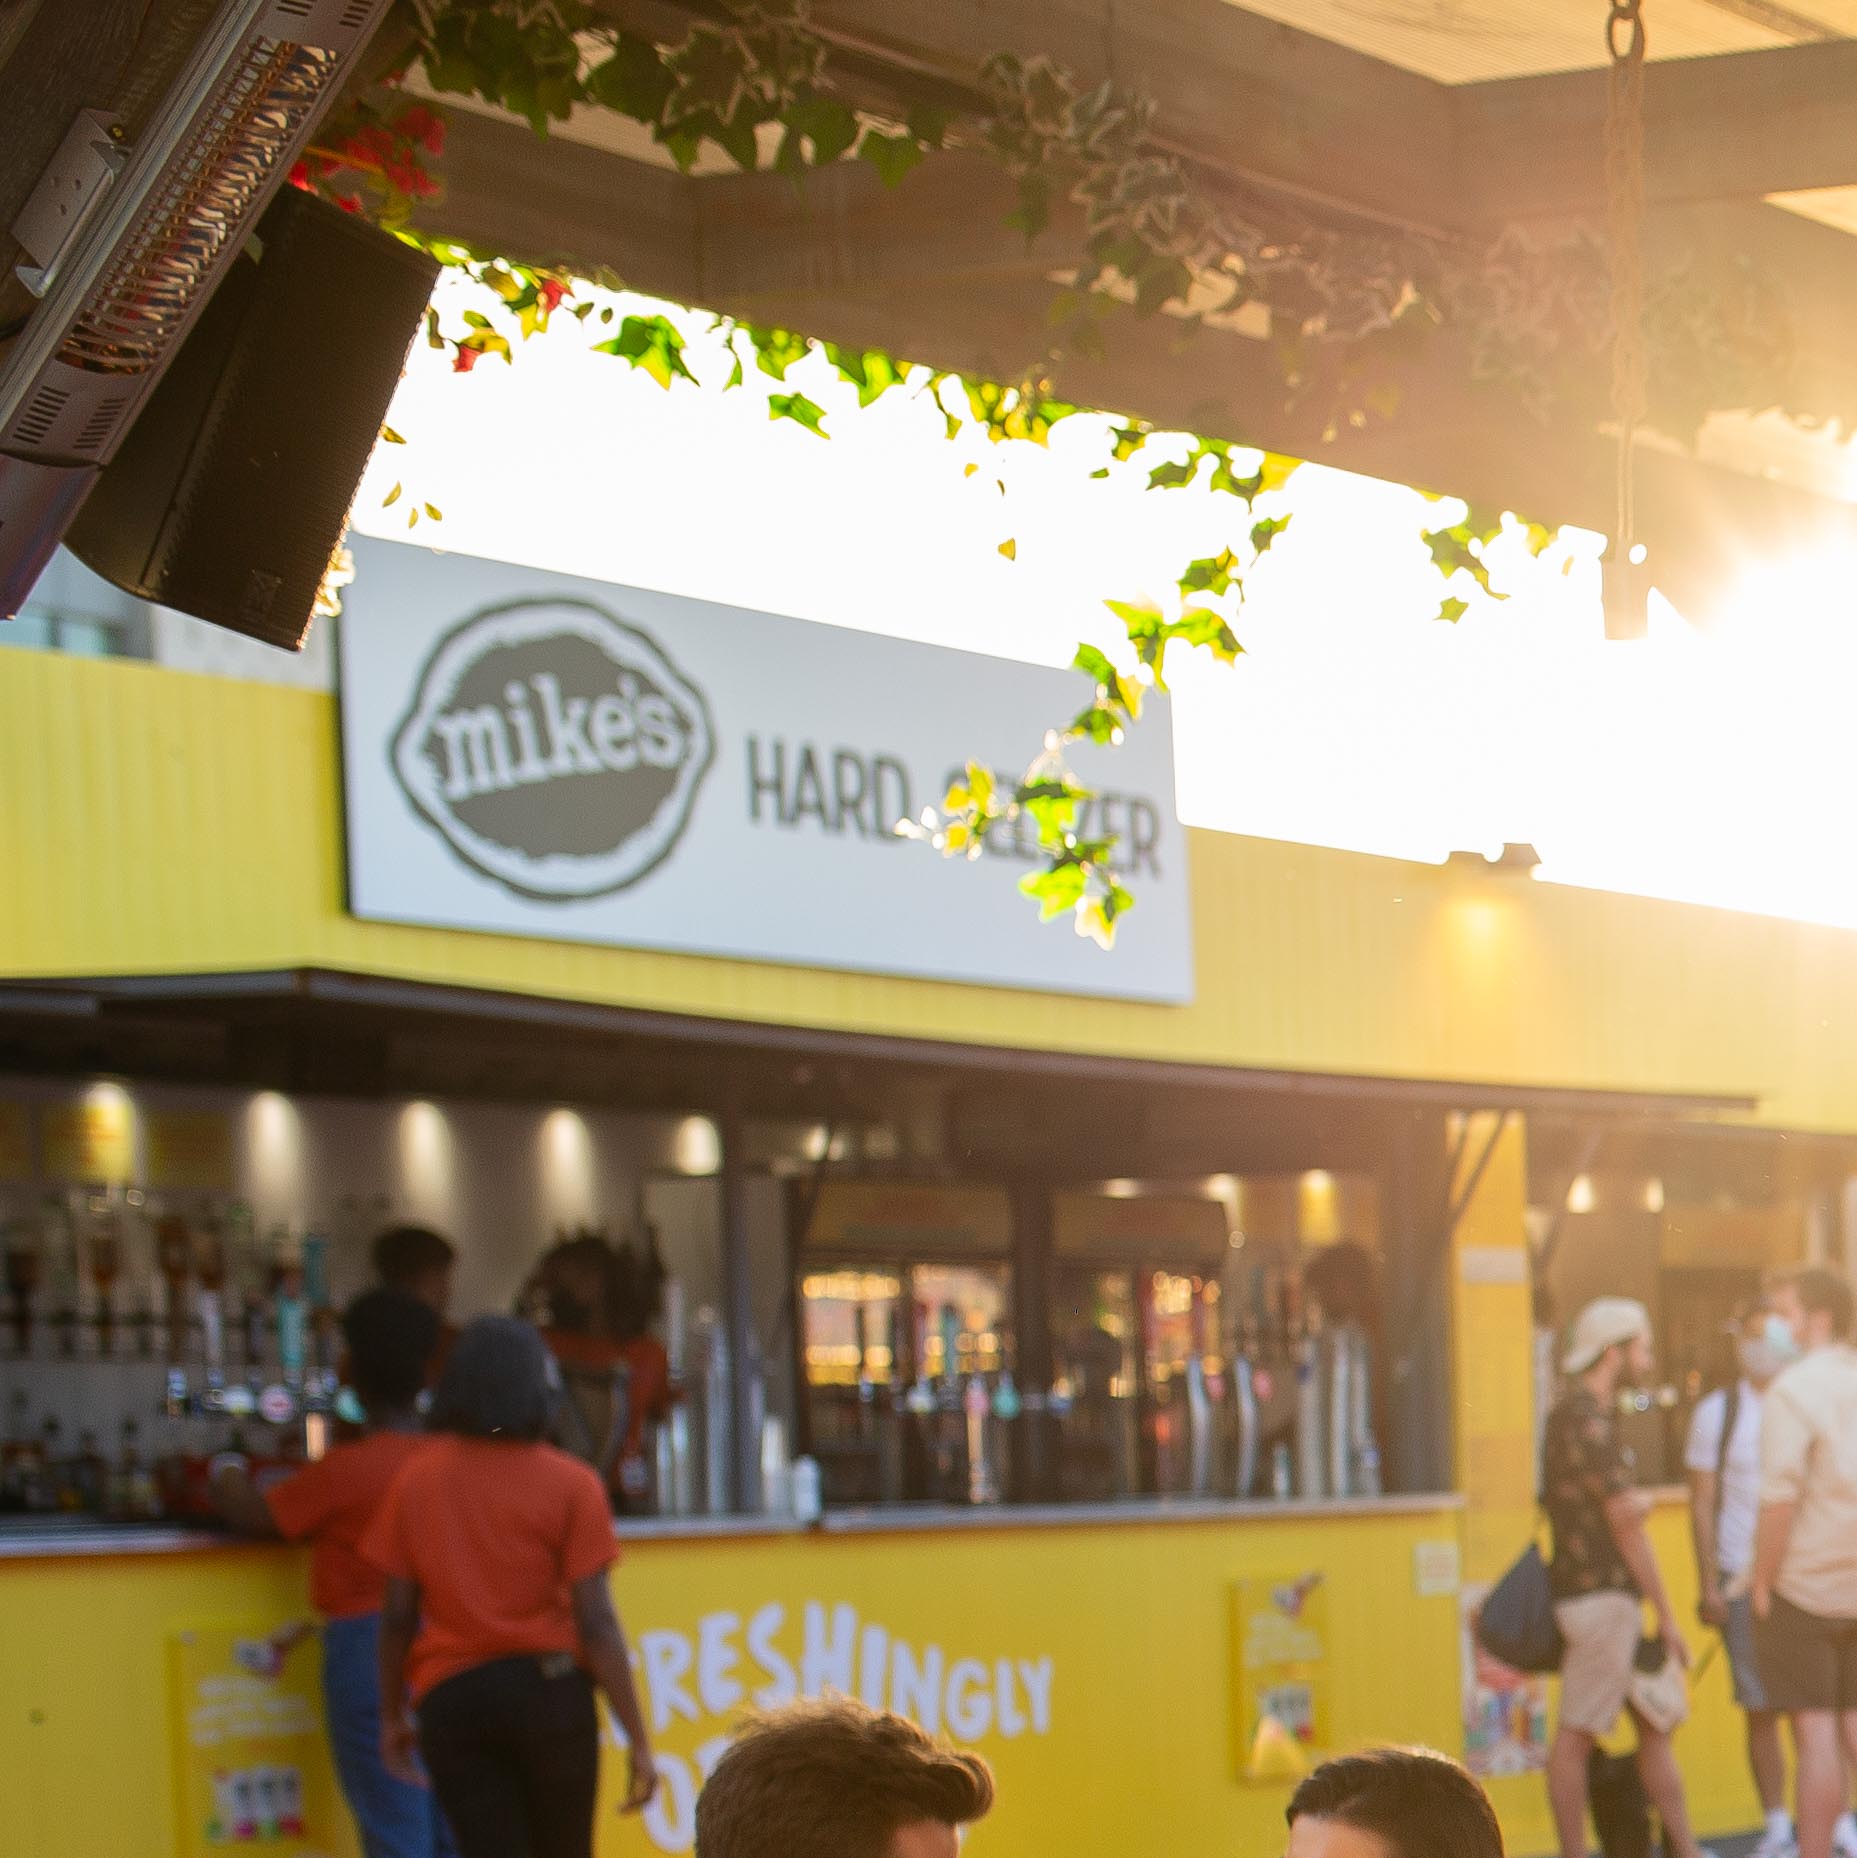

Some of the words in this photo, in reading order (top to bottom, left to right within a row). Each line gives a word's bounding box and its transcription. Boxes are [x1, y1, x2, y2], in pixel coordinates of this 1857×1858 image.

[433, 671, 687, 801] mike's
[746, 734, 912, 843] HARD
[605, 1601, 1054, 1746] RESHINGLY
